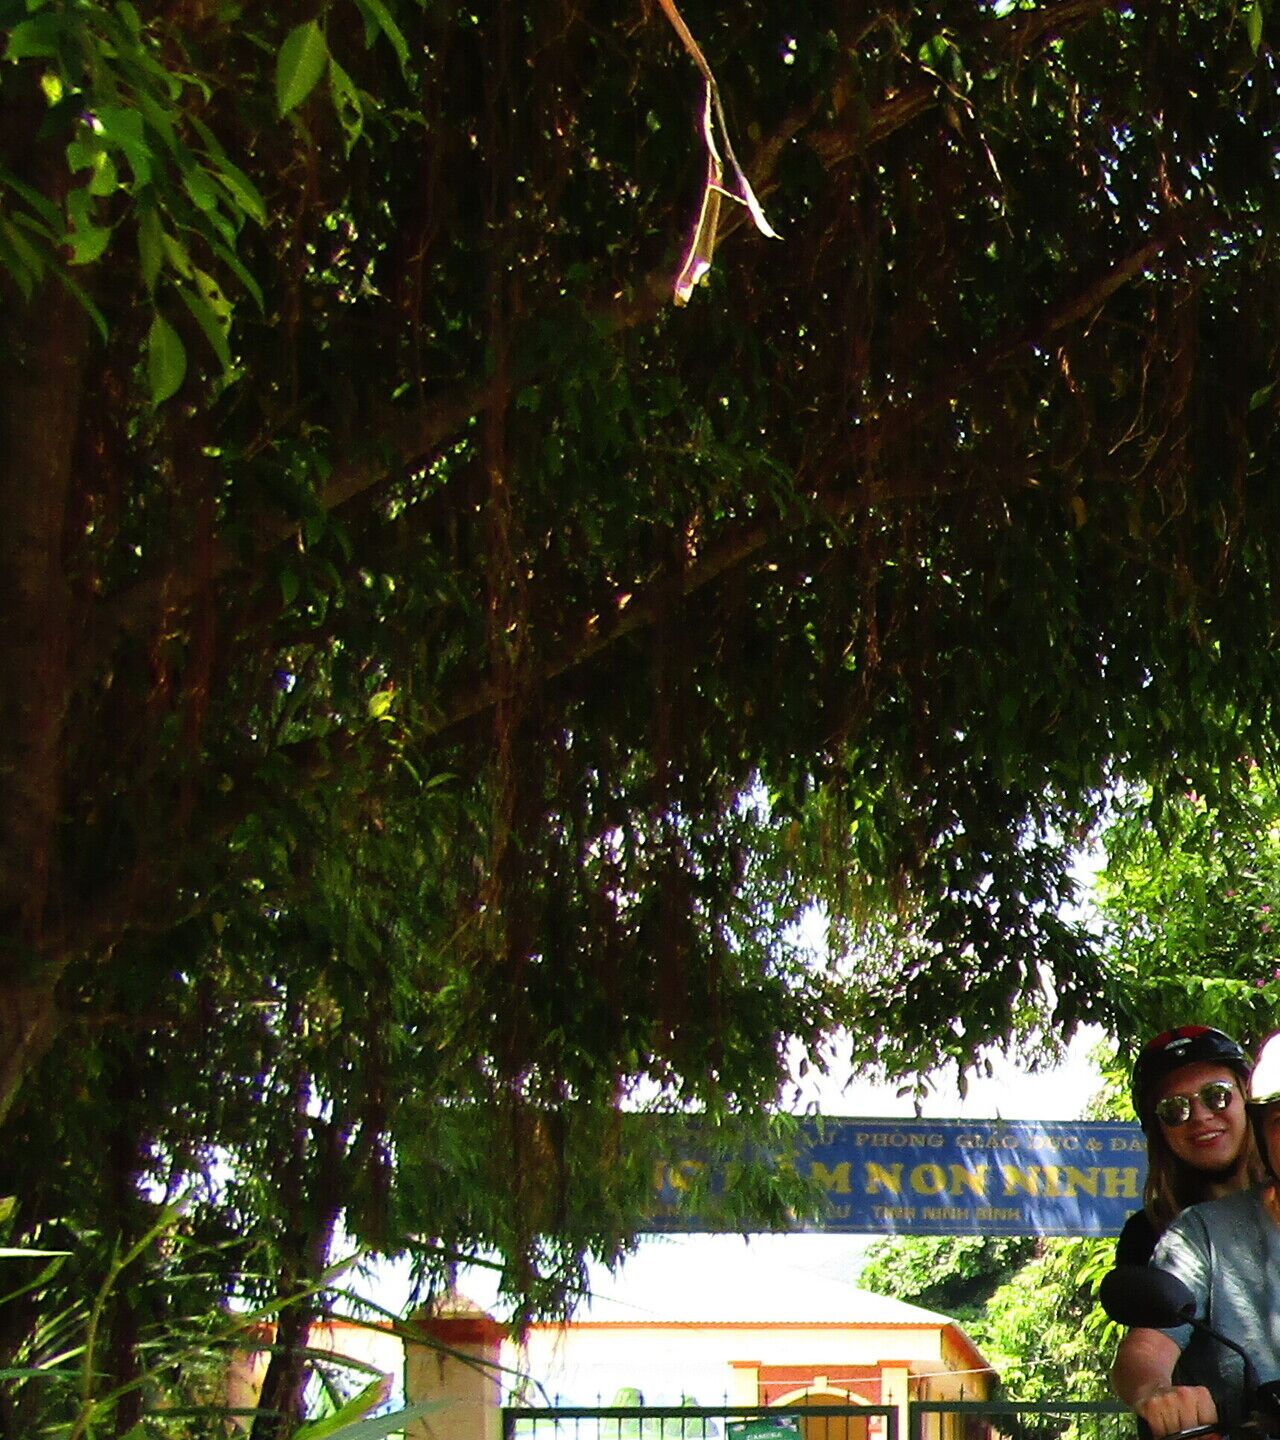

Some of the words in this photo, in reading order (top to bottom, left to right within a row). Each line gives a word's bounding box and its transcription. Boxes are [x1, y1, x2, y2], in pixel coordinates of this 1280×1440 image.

[1086, 1137, 1104, 1151] &
[865, 1162, 990, 1198] NON
[1001, 1164, 1140, 1198] NINH
